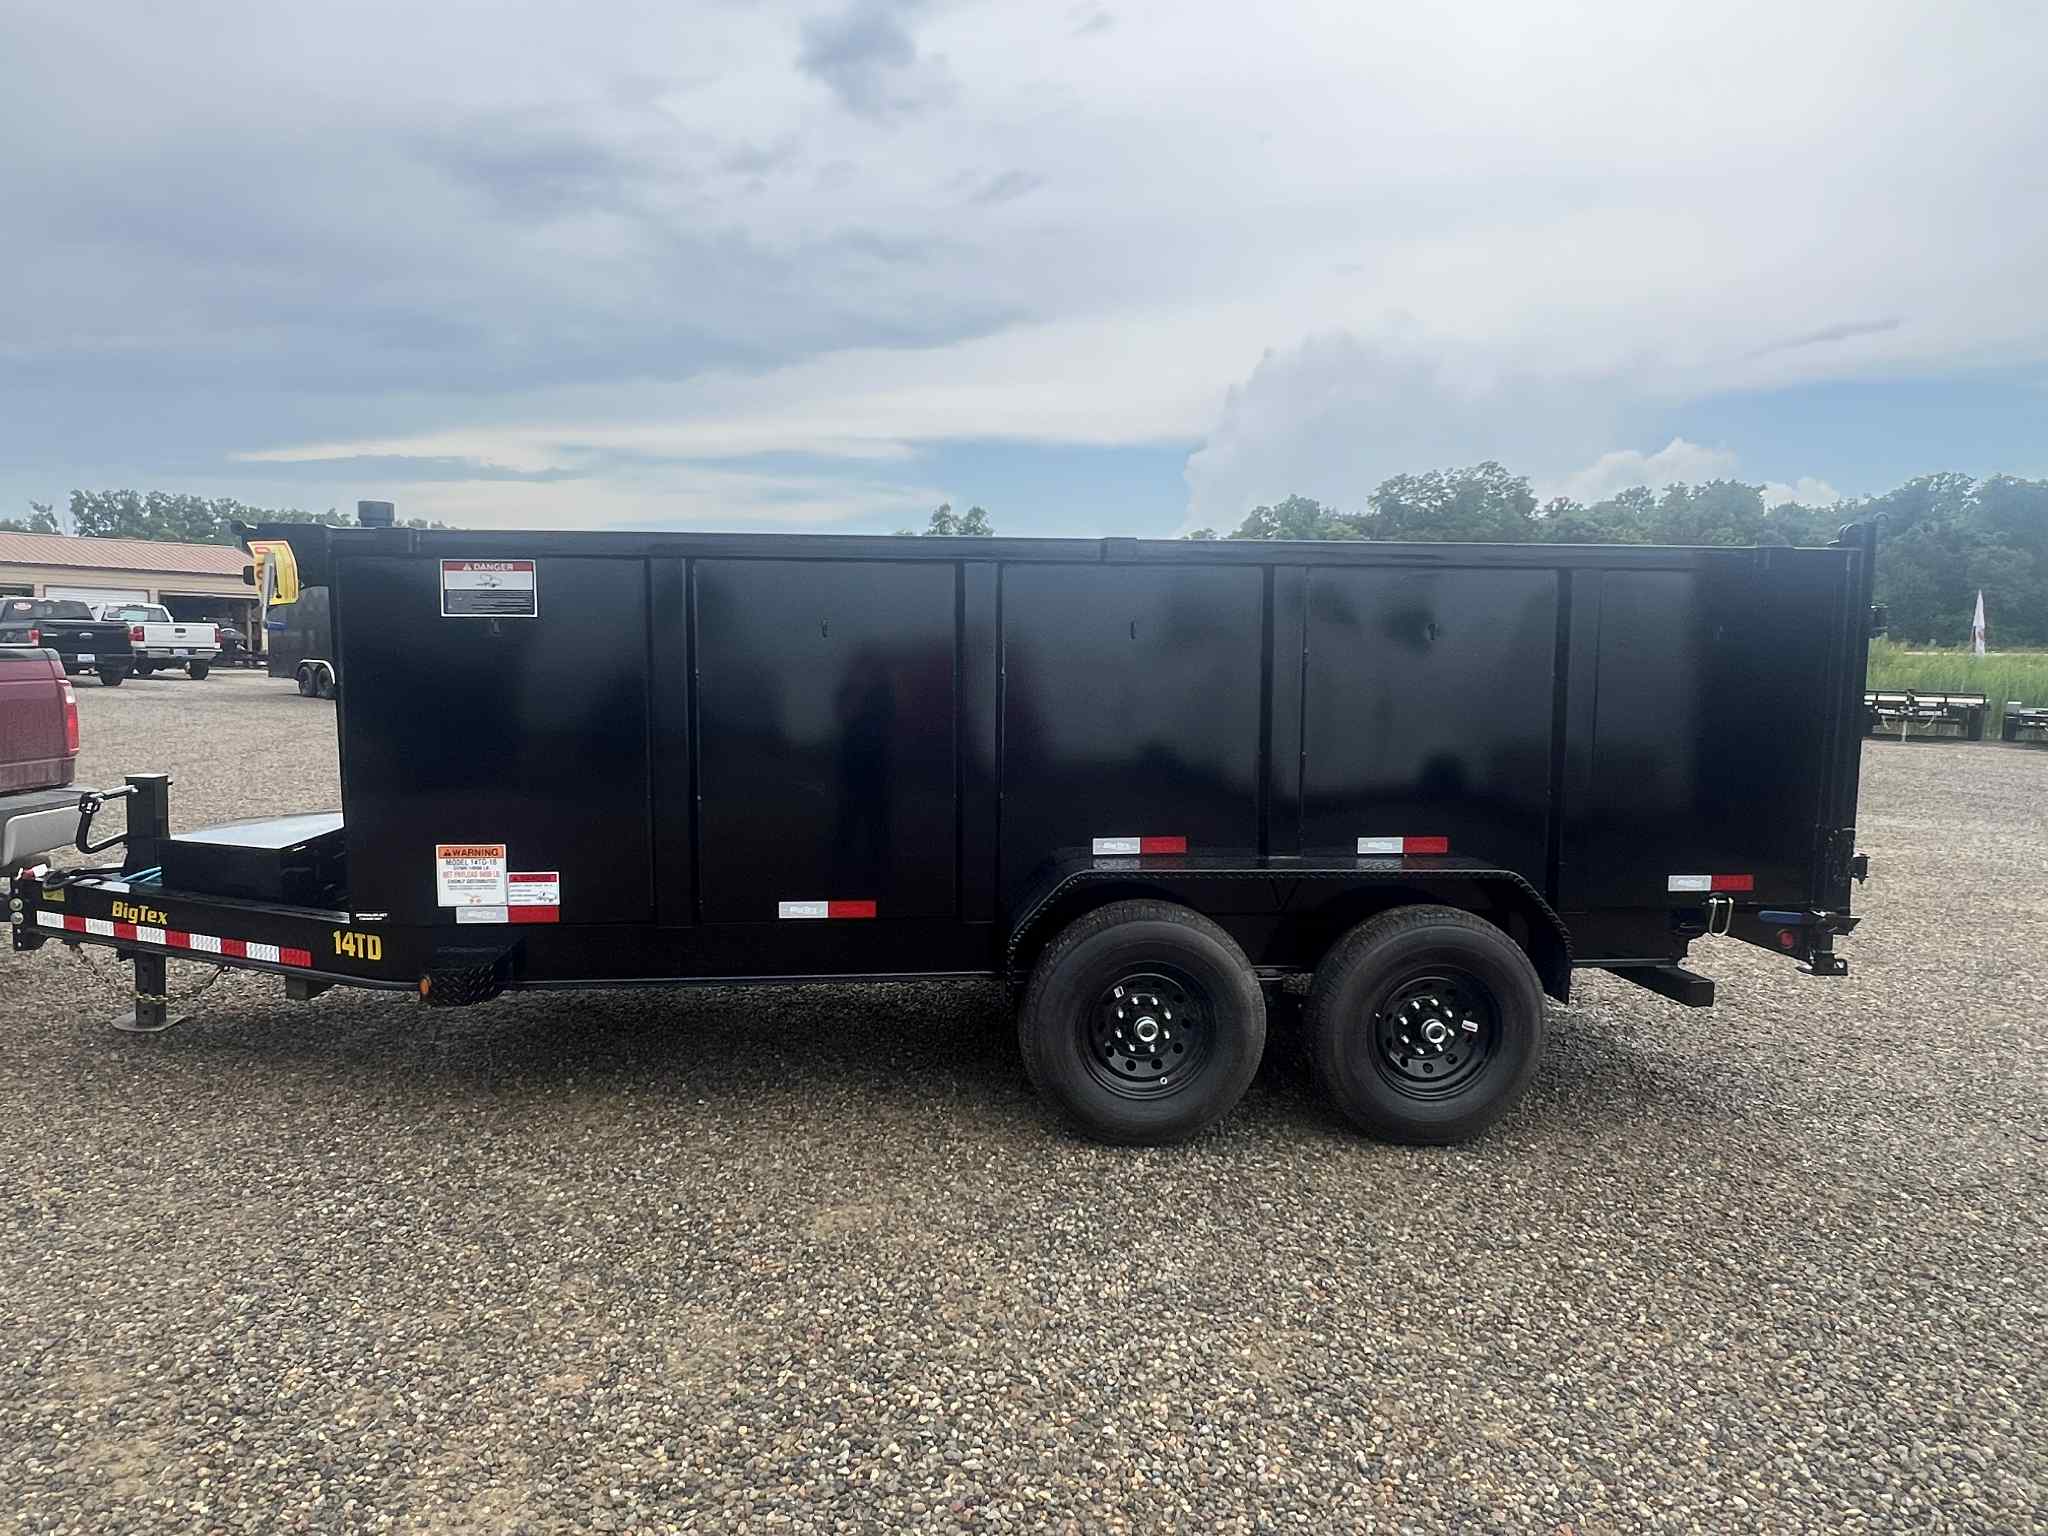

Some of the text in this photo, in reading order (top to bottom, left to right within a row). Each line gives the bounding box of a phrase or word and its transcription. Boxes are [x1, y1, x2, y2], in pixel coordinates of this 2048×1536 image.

[473, 563, 514, 571] DANGER
[452, 848, 499, 856] WARNING
[112, 900, 168, 925] BigTex
[333, 930, 382, 960] 14TD
